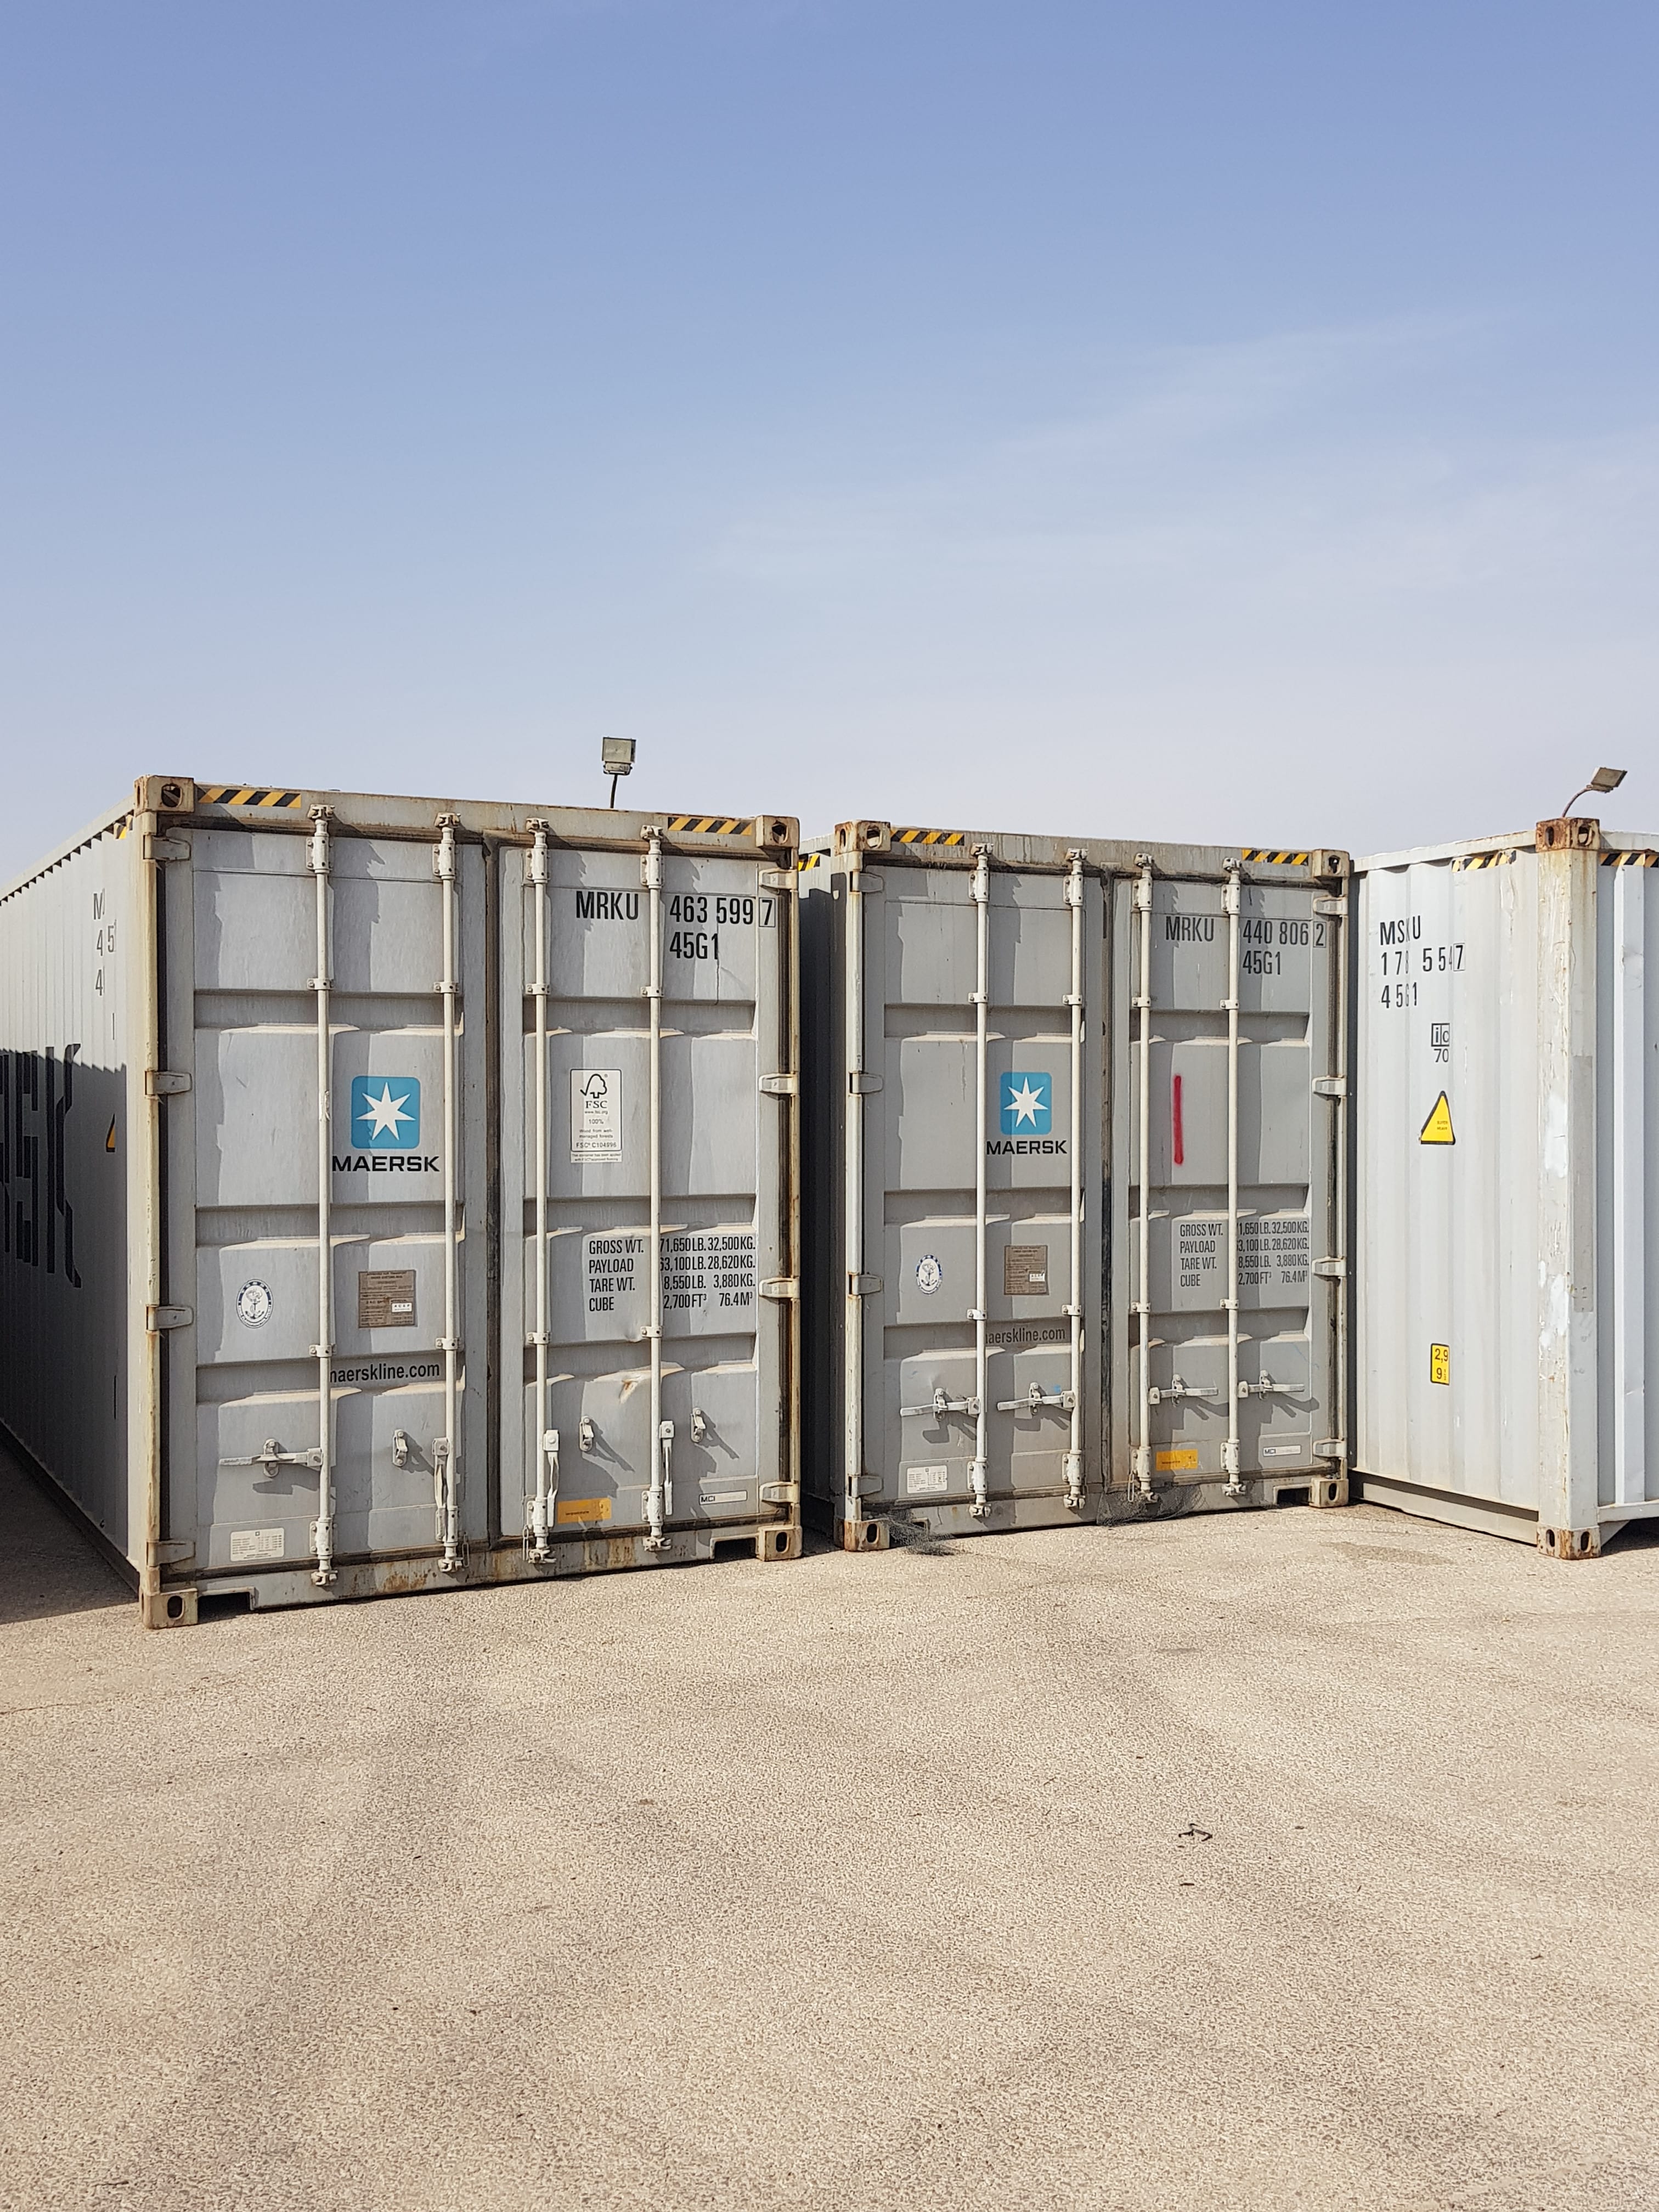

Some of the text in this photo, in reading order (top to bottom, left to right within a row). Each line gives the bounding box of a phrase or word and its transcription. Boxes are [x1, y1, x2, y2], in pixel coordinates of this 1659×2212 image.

[576, 891, 772, 926] MRKU 463 599 7
[1166, 916, 1324, 946] MRKU 440 806 2
[1380, 916, 1421, 945] MSKU
[669, 932, 718, 960] 45G1
[1243, 951, 1280, 975] 45G1
[1381, 982, 1417, 1008] 45G1
[1434, 1048, 1449, 1062] 70
[986, 1140, 1067, 1155] MAERSK
[332, 1156, 440, 1171] MAERSK
[1180, 1223, 1206, 1237] GROSS
[1209, 1223, 1223, 1236] WT.
[589, 1240, 623, 1255] GROSS
[625, 1239, 644, 1254] WT.
[1180, 1240, 1215, 1254] PAYLOAD
[589, 1258, 634, 1274] PAYLOAD
[1181, 1257, 1200, 1271] TARE
[1202, 1257, 1217, 1269] WT.
[589, 1277, 614, 1293] TARE
[617, 1277, 635, 1291] WT.
[1181, 1274, 1201, 1287] CUBE
[589, 1296, 614, 1312] CUBE
